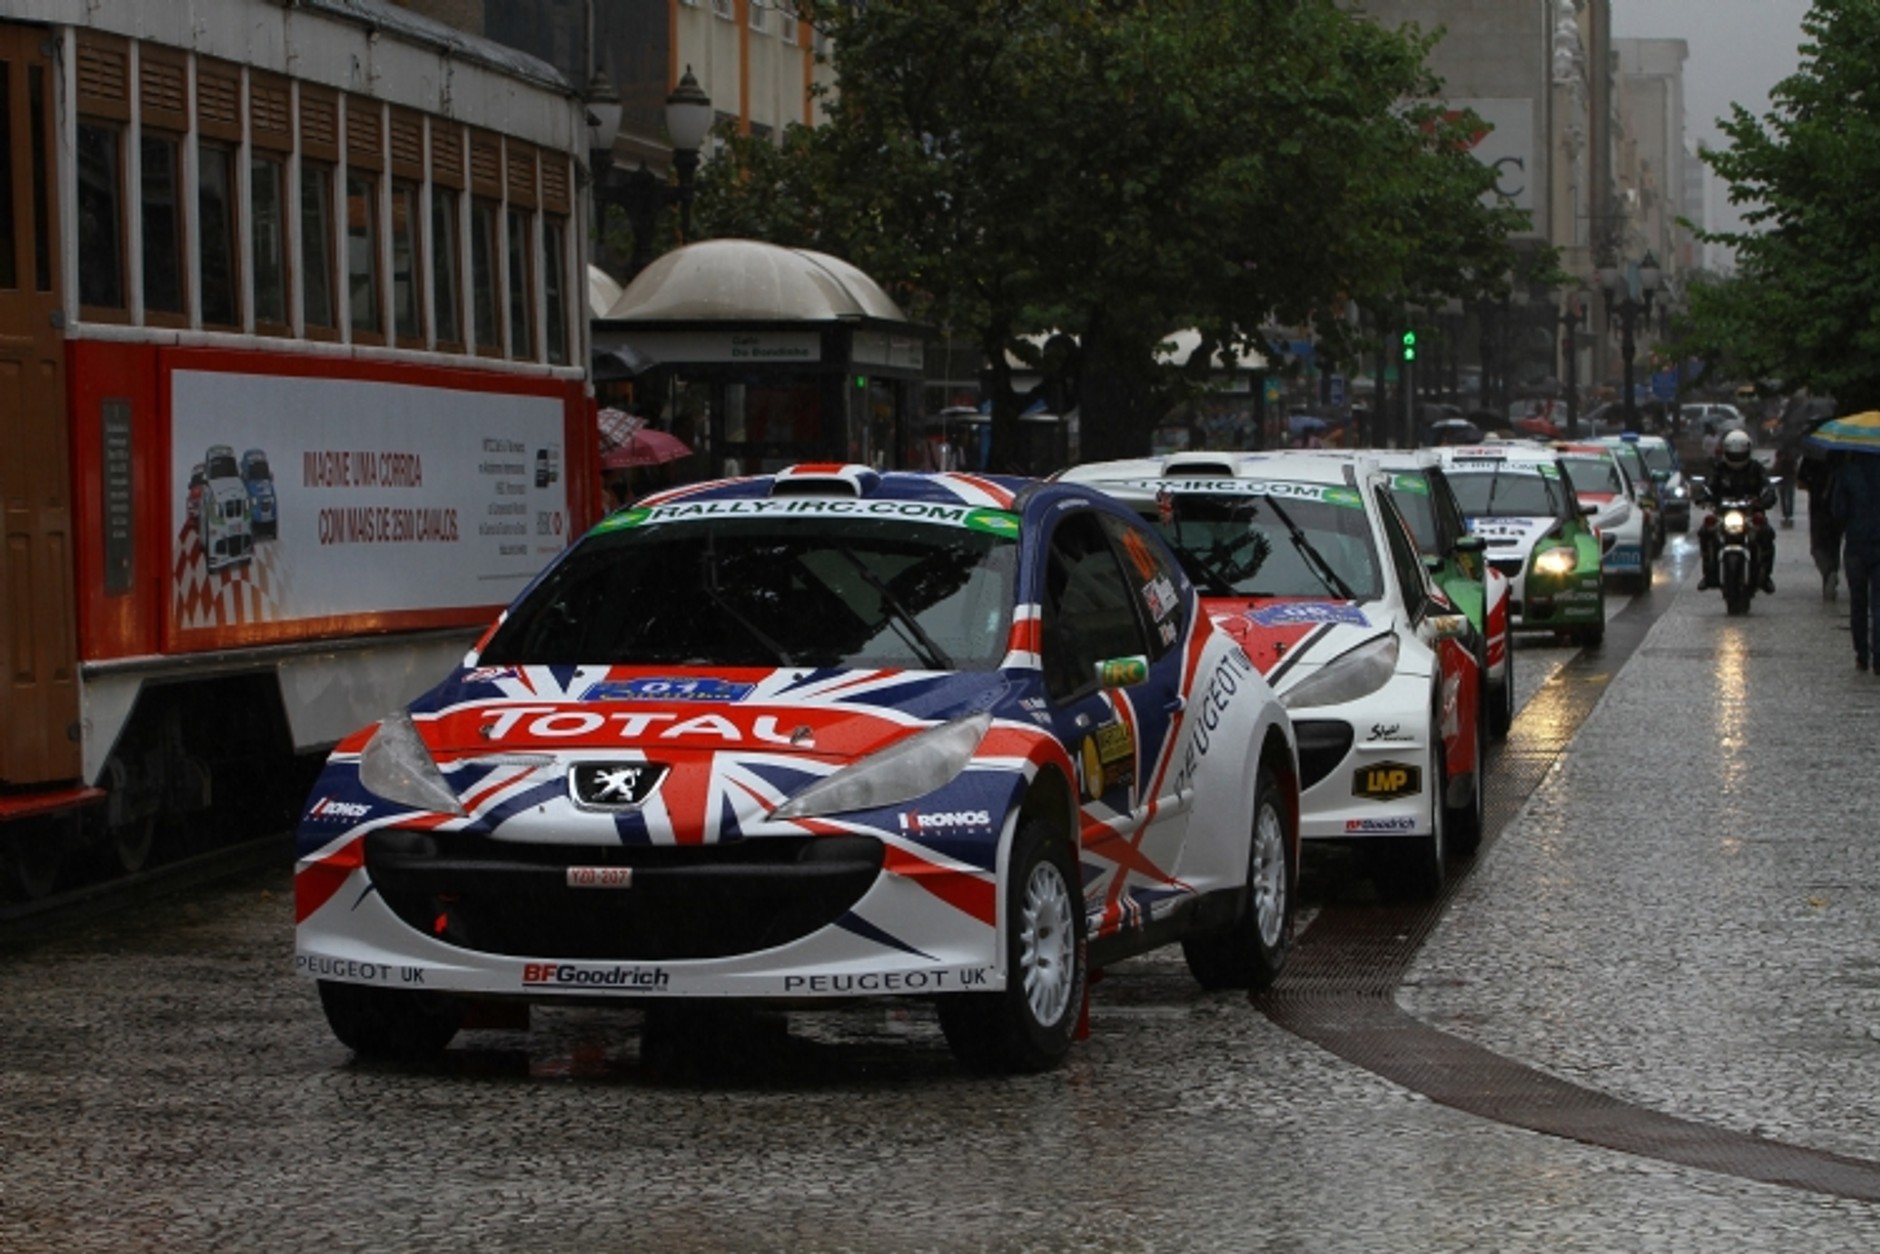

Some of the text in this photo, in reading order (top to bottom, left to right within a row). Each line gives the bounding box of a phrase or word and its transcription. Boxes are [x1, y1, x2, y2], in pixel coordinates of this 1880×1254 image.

[352, 451, 377, 487] UMA
[379, 452, 422, 487] CORRIDA
[652, 501, 966, 521] RALLY-IRC.COM
[319, 507, 345, 544] COM
[347, 507, 375, 543] MAIS
[376, 507, 391, 542] DE
[481, 706, 816, 748] TOTAL
[1367, 770, 1408, 791] LMP
[898, 807, 991, 832] KRONOS
[296, 956, 425, 984] PEUGEOT UK
[522, 962, 670, 985] BFGoodrich
[784, 968, 987, 992] PEUGEOT UK
